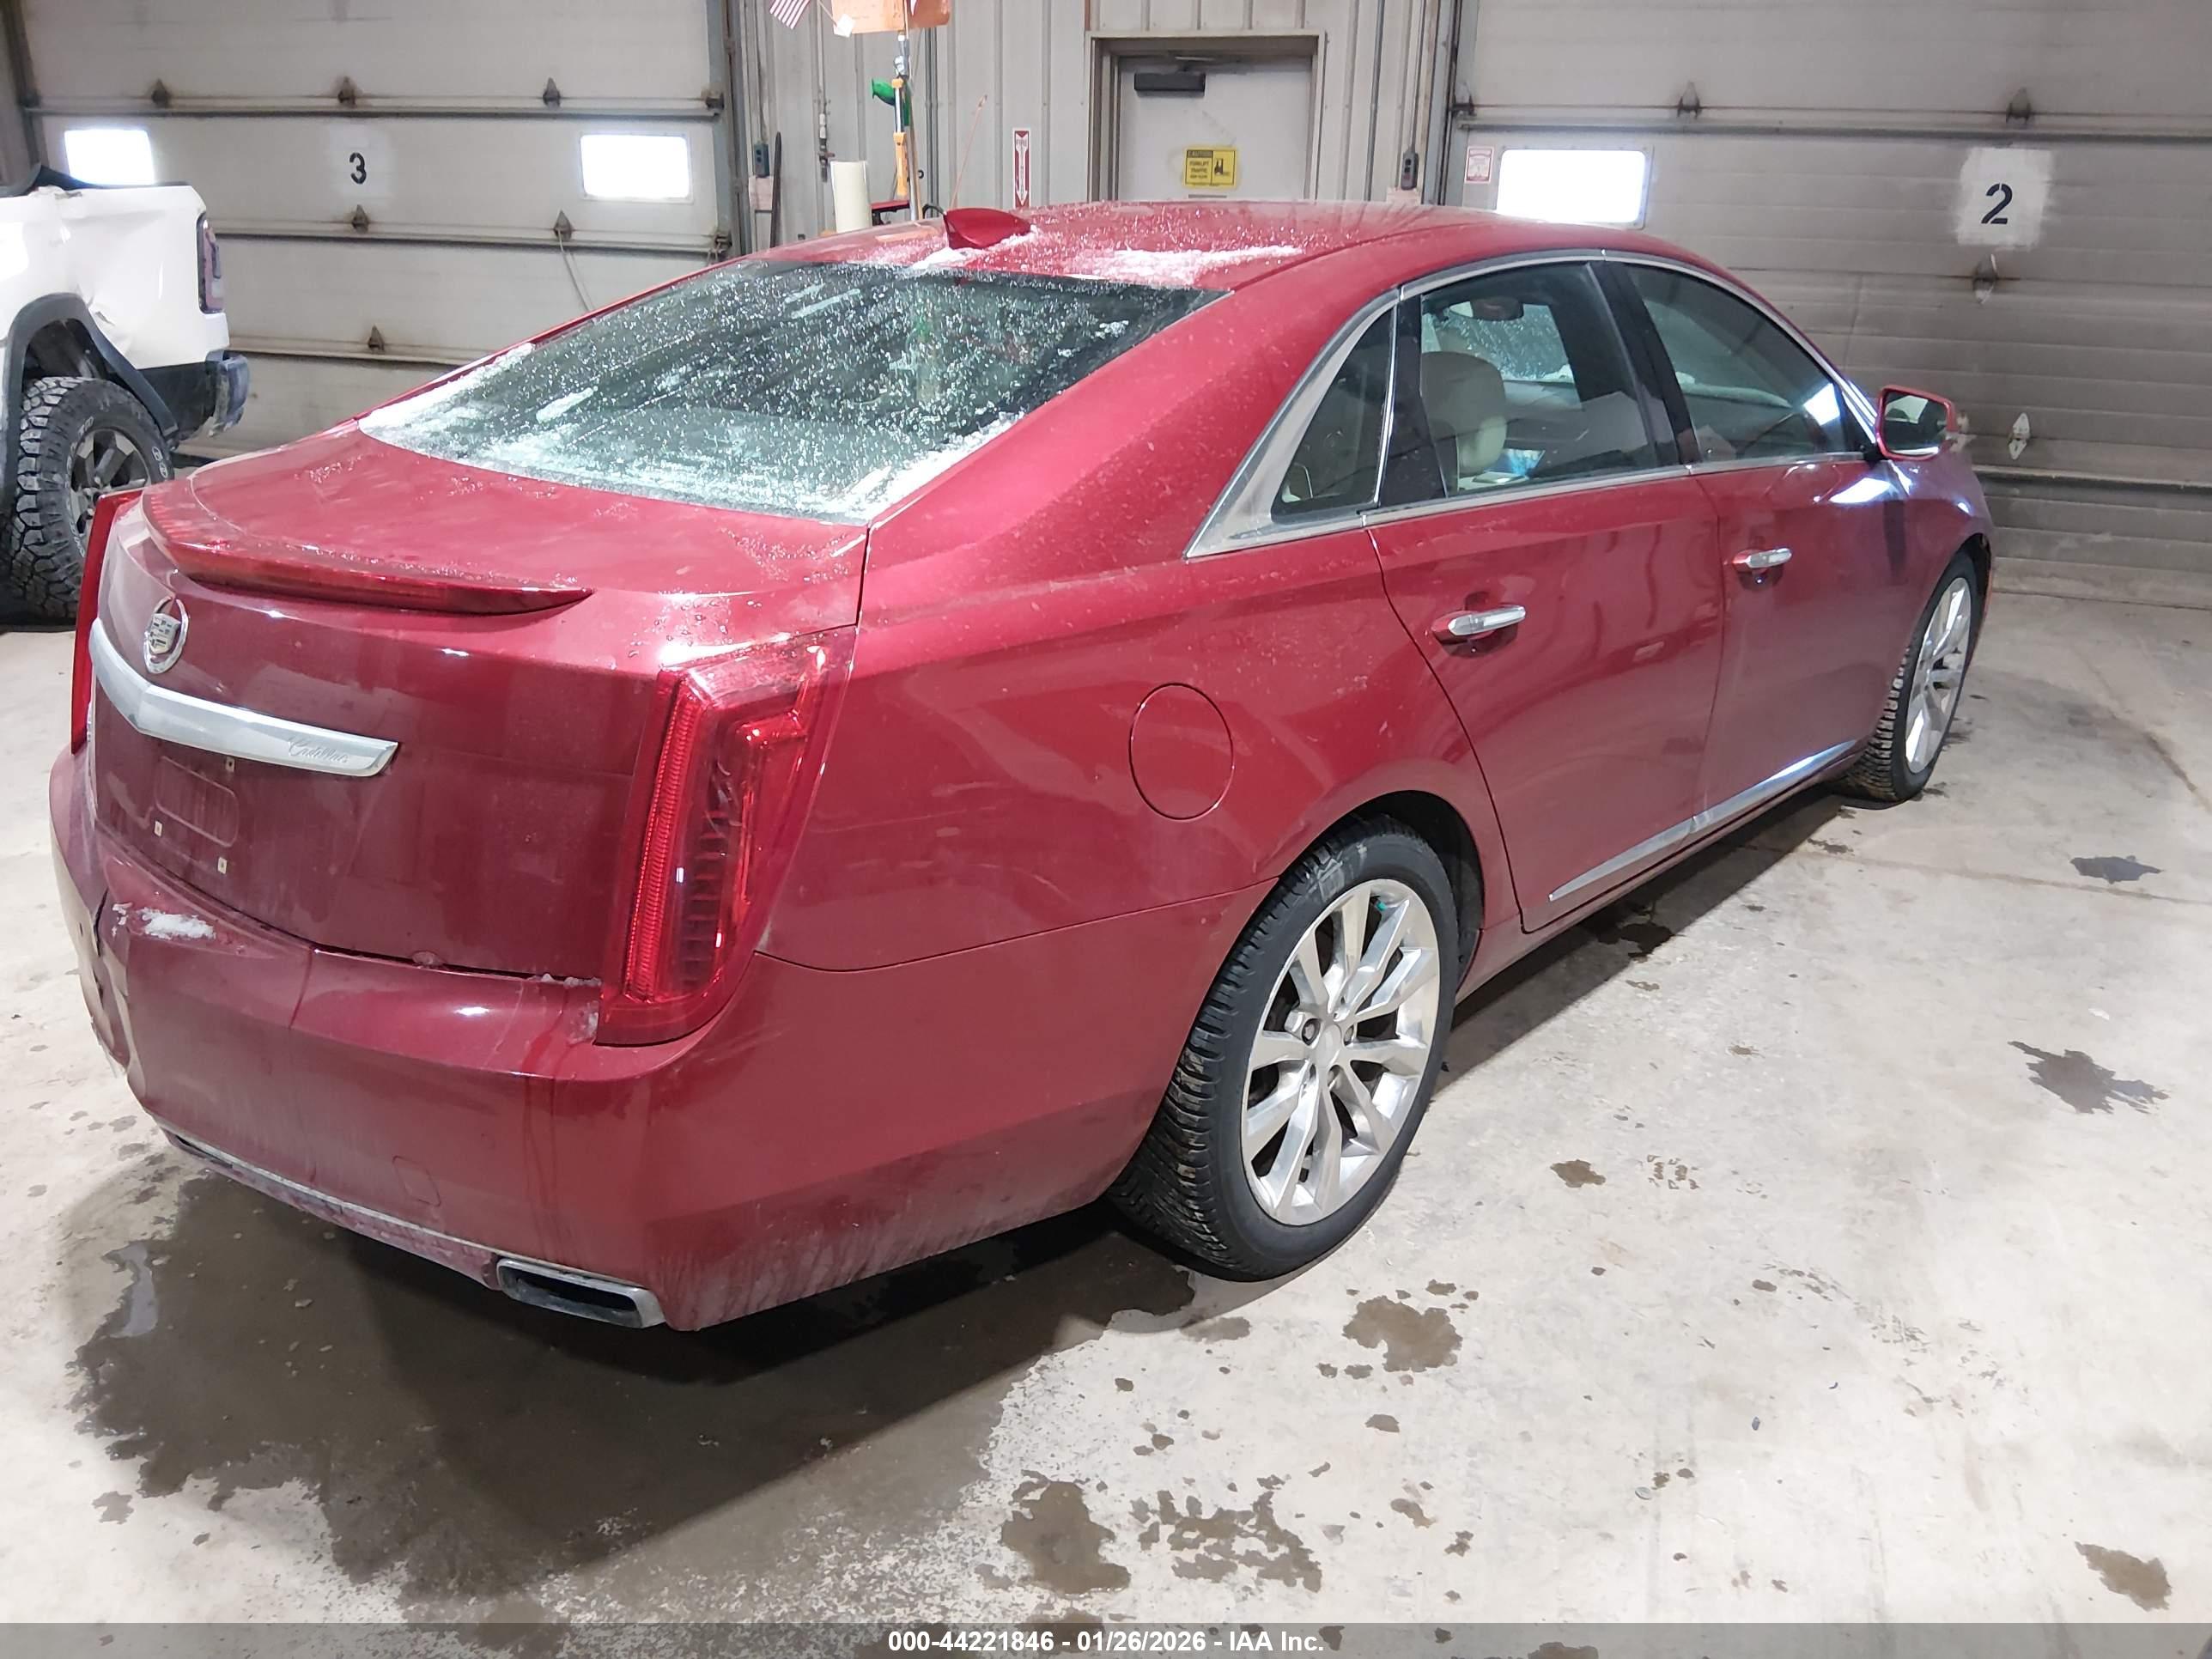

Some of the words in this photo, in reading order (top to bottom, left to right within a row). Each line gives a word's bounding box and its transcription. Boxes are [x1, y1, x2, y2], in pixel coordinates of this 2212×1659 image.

[349, 152, 367, 185] 3
[1981, 183, 2013, 225] 2
[289, 737, 349, 763] Cadillac
